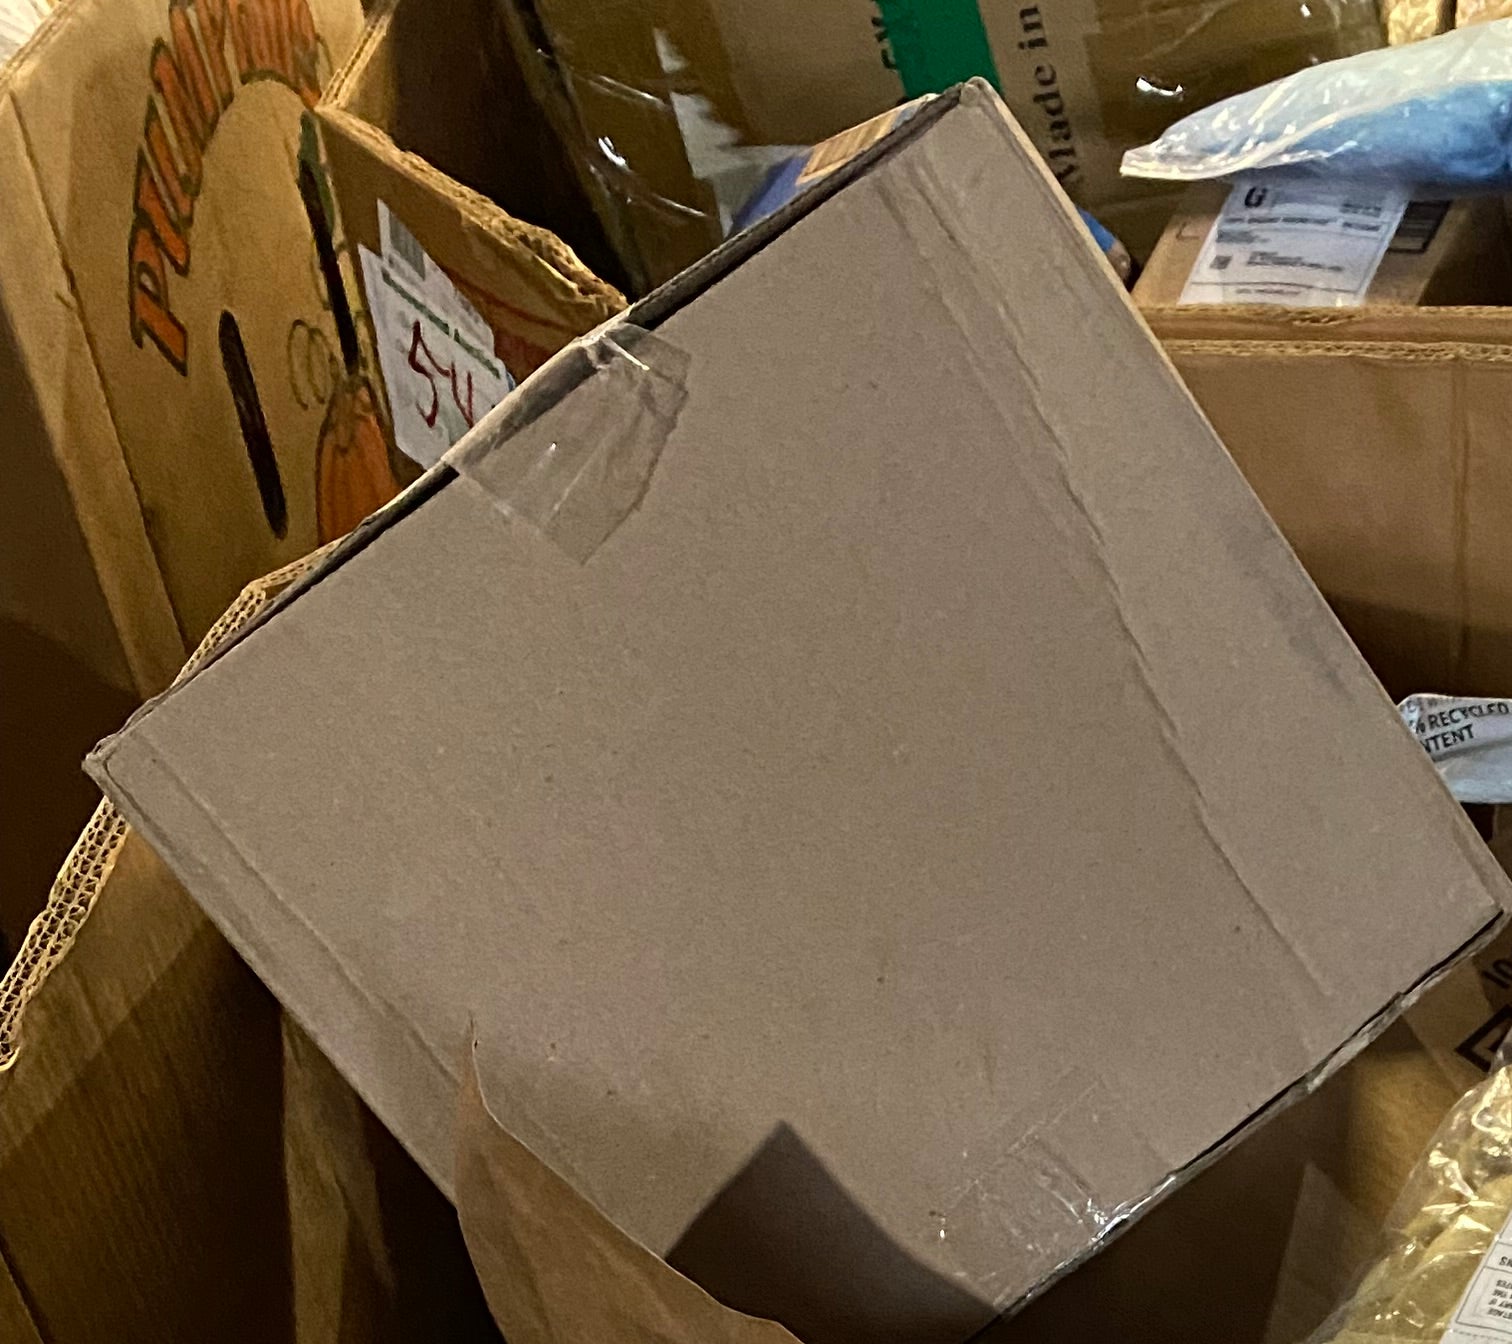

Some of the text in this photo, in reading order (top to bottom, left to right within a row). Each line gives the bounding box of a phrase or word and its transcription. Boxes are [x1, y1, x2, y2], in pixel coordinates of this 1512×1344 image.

[1018, 7, 1047, 50] in
[1428, 700, 1511, 729] RECYCLED
[1421, 723, 1476, 754] NTENT
